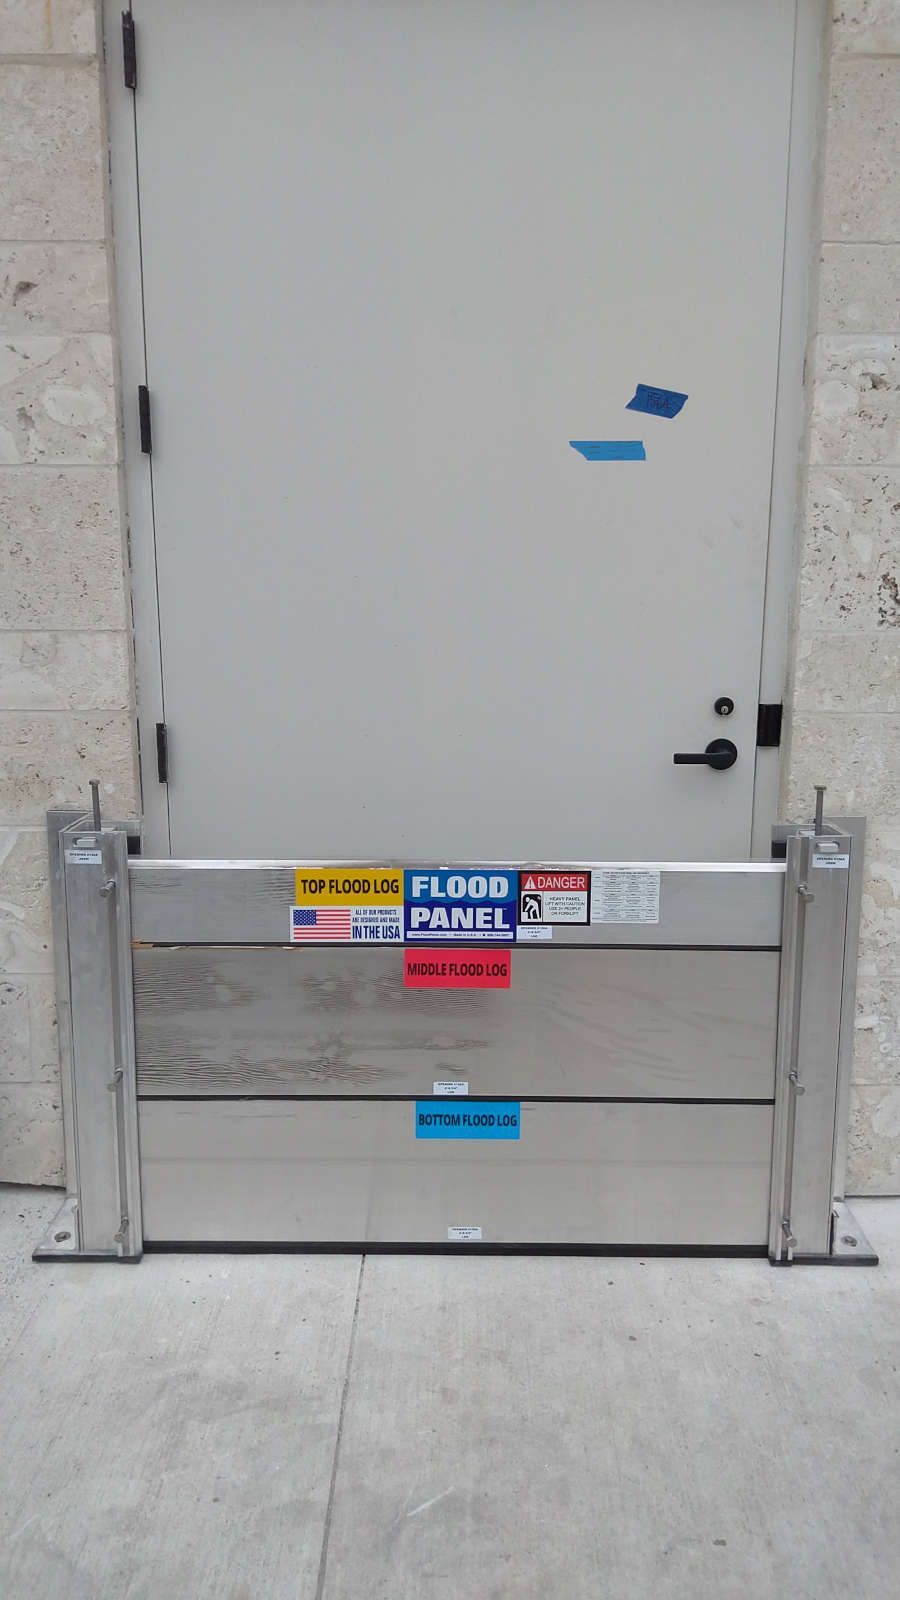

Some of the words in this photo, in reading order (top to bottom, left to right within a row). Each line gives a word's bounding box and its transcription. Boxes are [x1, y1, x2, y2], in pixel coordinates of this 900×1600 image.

[301, 879, 326, 894] TOP
[328, 879, 371, 894] FLOOD
[374, 879, 399, 894] LOG
[411, 875, 509, 899] FLOOD
[537, 876, 585, 889] DANGER
[410, 907, 510, 929] PANEL
[352, 925, 362, 939] IN
[364, 925, 380, 939] THE
[382, 925, 401, 939] USA
[407, 962, 447, 976] MIDDLE
[449, 963, 484, 976] FLOOD
[486, 963, 507, 977] LOG
[418, 1113, 460, 1126] BOTTOM
[462, 1114, 495, 1127] FLOOD
[497, 1114, 517, 1127] LOG
